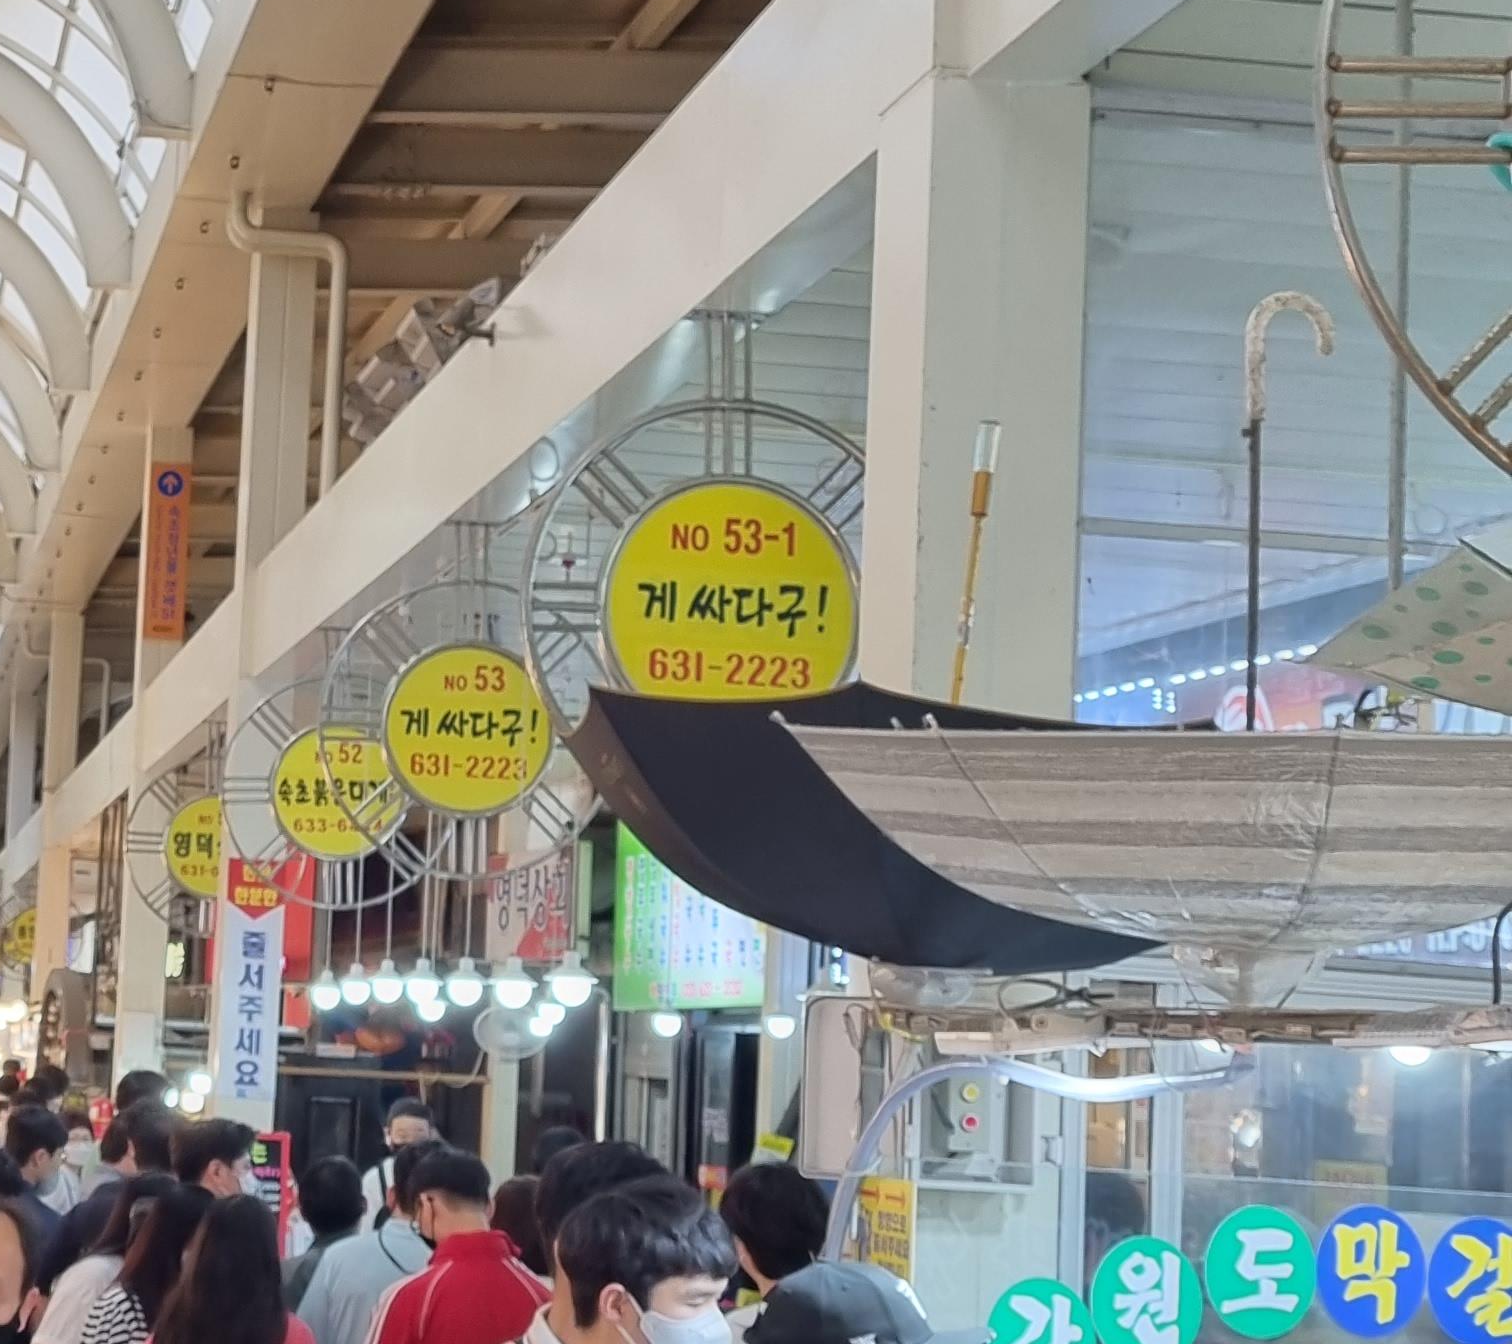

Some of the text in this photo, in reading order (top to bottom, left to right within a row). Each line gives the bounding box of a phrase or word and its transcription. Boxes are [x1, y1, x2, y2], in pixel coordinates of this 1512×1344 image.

[671, 518, 795, 556] NO 53-1
[638, 581, 828, 638] 게 싸다구!
[444, 665, 505, 692] NO 53
[649, 648, 810, 689] 631-2223
[401, 707, 538, 747] 게 싸다구!
[339, 743, 362, 763] 52
[410, 753, 527, 780] 631-2223
[174, 832, 221, 859] 영덕
[234, 931, 266, 1087] 줄서주세요
